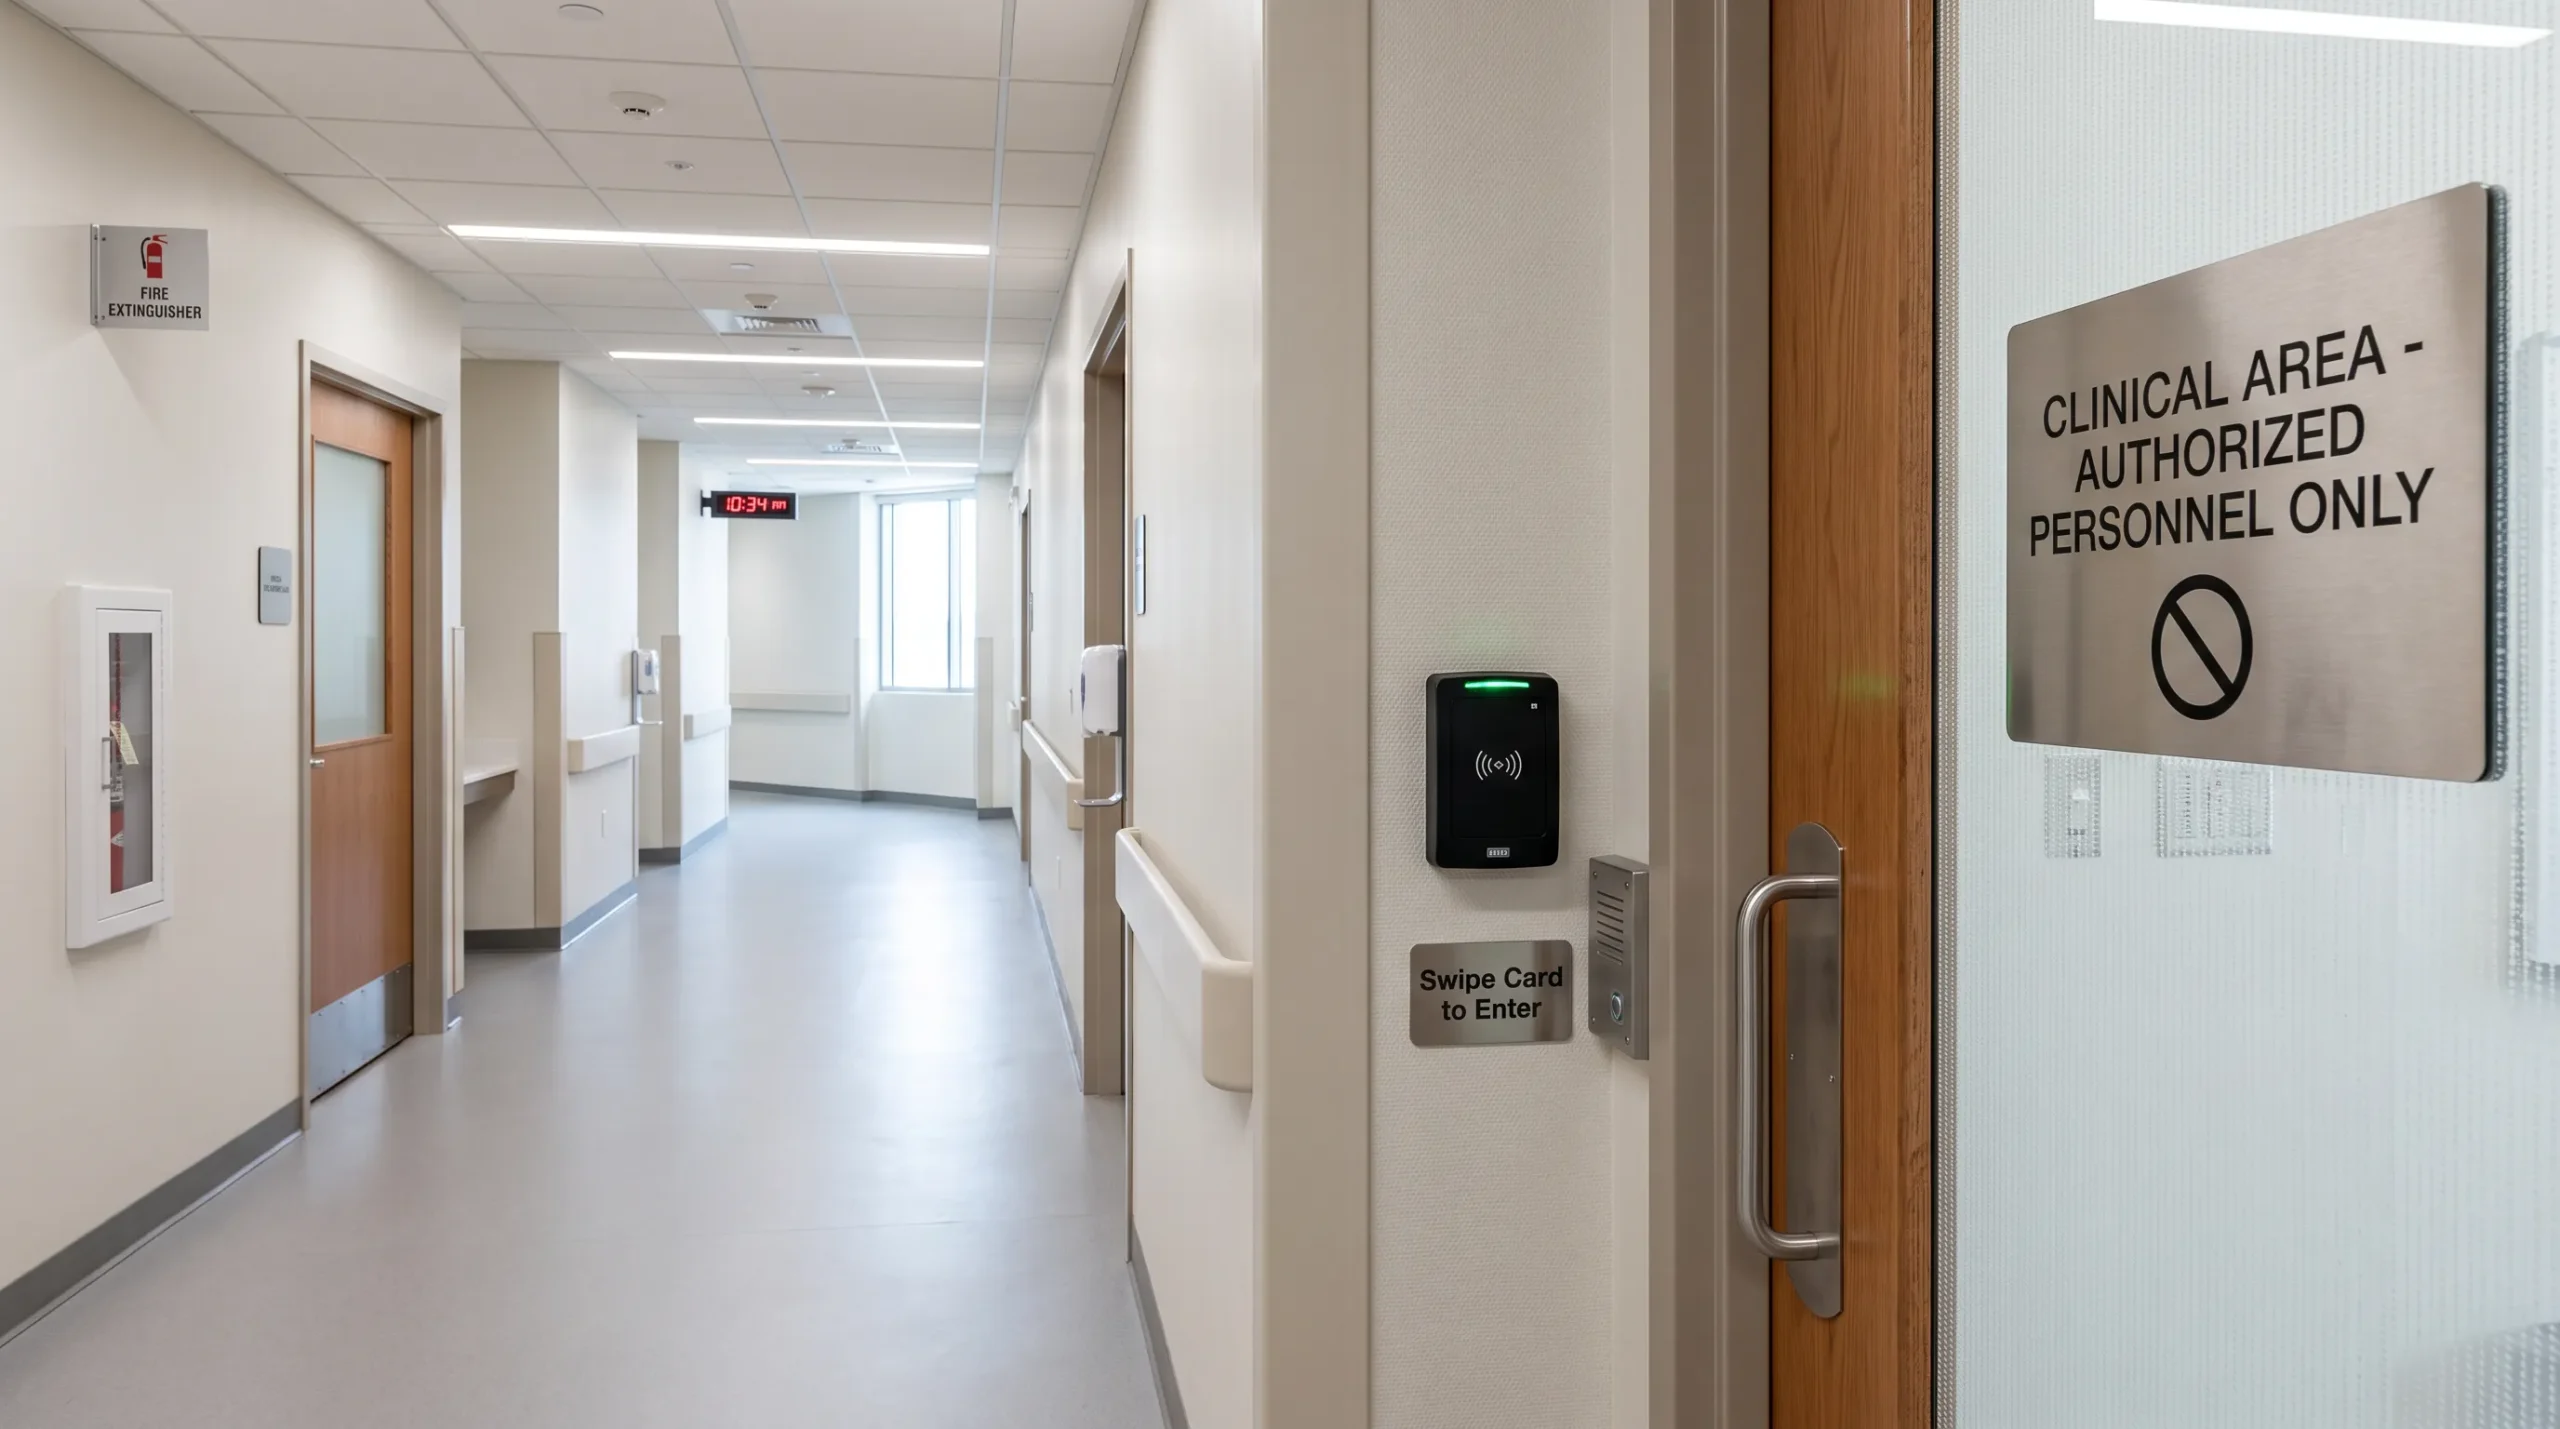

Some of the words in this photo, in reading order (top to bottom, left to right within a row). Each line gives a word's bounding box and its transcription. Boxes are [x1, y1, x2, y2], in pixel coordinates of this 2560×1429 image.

[141, 287, 169, 300] FIRE
[108, 304, 202, 319] EXTINGUISHER
[2043, 361, 2229, 438] CLINICAL
[2242, 324, 2387, 401] AREA
[2075, 403, 2365, 493] AUTHORIZED
[726, 496, 768, 512] 10:34
[2030, 489, 2274, 556] PERSONNEL
[2289, 467, 2434, 534] ONLY
[1420, 969, 1496, 994] Swipe
[1504, 966, 1563, 989] Card
[1441, 1000, 1467, 1021] to
[1475, 998, 1542, 1020] Enter
